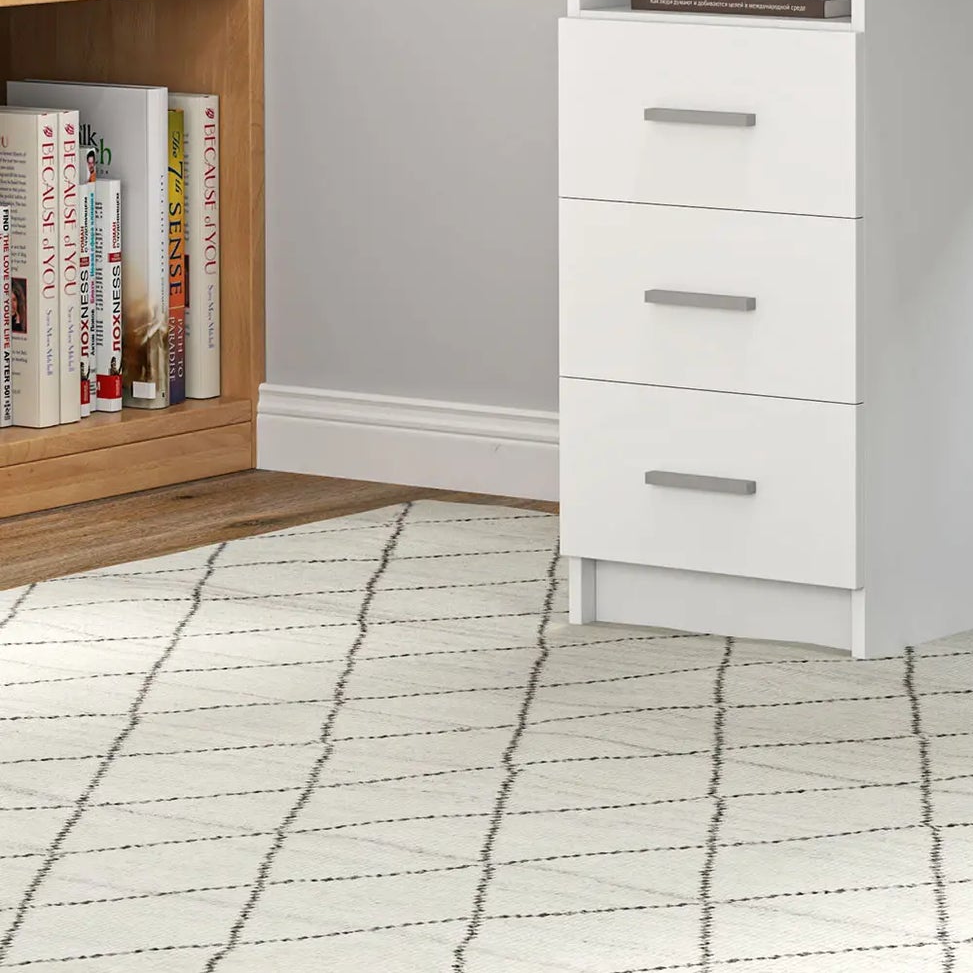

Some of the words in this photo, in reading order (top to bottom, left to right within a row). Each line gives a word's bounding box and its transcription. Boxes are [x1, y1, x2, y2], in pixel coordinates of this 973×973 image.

[698, 0, 728, 8] добиваются
[171, 131, 181, 159] The
[63, 140, 77, 230] BECAUSE
[204, 124, 217, 212] BECAUSE
[42, 143, 56, 234] BECAUSE
[204, 216, 216, 228] of
[42, 237, 56, 251] of
[63, 234, 77, 248] of
[169, 202, 182, 295] SENSE
[204, 228, 217, 275] YOU
[4, 283, 9, 296] OF
[42, 251, 56, 300] YOU
[63, 248, 77, 297] YOU
[177, 358, 184, 378] TO
